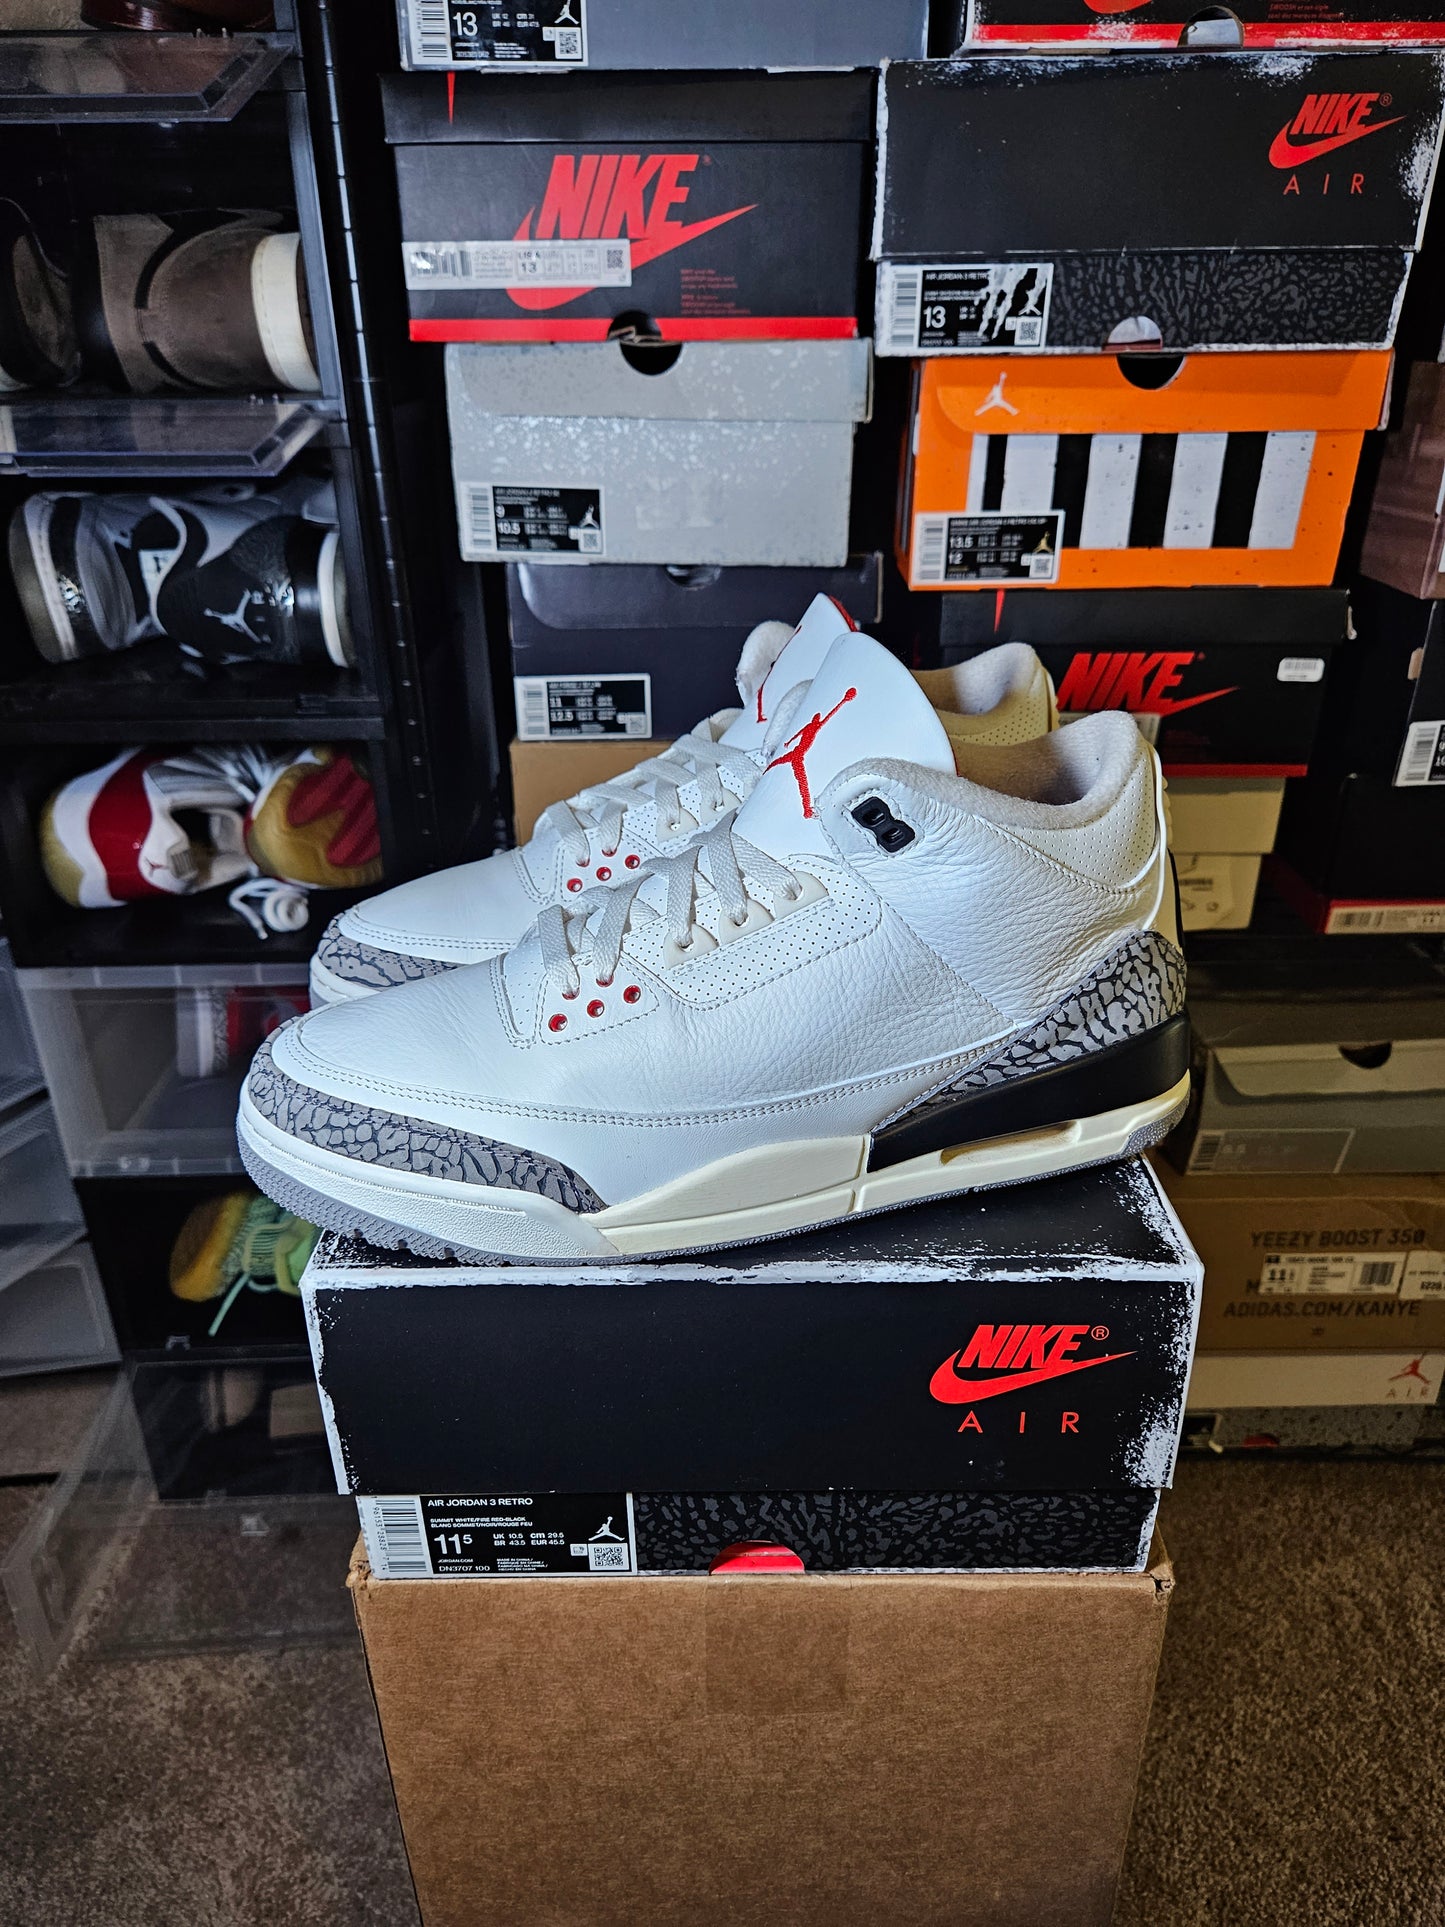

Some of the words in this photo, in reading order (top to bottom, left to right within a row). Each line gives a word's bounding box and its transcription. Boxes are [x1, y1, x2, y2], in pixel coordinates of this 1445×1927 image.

[453, 12, 479, 36] 13
[1289, 93, 1380, 135] NIKE
[1283, 173, 1365, 195] AIR
[535, 154, 699, 240] NIKE
[923, 305, 947, 329] 13
[1056, 652, 1195, 712] NIKE
[1251, 1231, 1314, 1248] YEEZY
[1318, 1230, 1382, 1247] BOOST
[1387, 1229, 1426, 1245] 350
[1224, 1301, 1421, 1318] ADIDAS.COM/KANYE
[957, 1325, 1091, 1369] NIKE
[1386, 1387, 1431, 1398] AIR
[957, 1410, 1080, 1434] AIR
[428, 1498, 445, 1507] AIR
[446, 1498, 488, 1507] JORDAN
[489, 1498, 497, 1506] 3
[498, 1497, 533, 1506] RETRO
